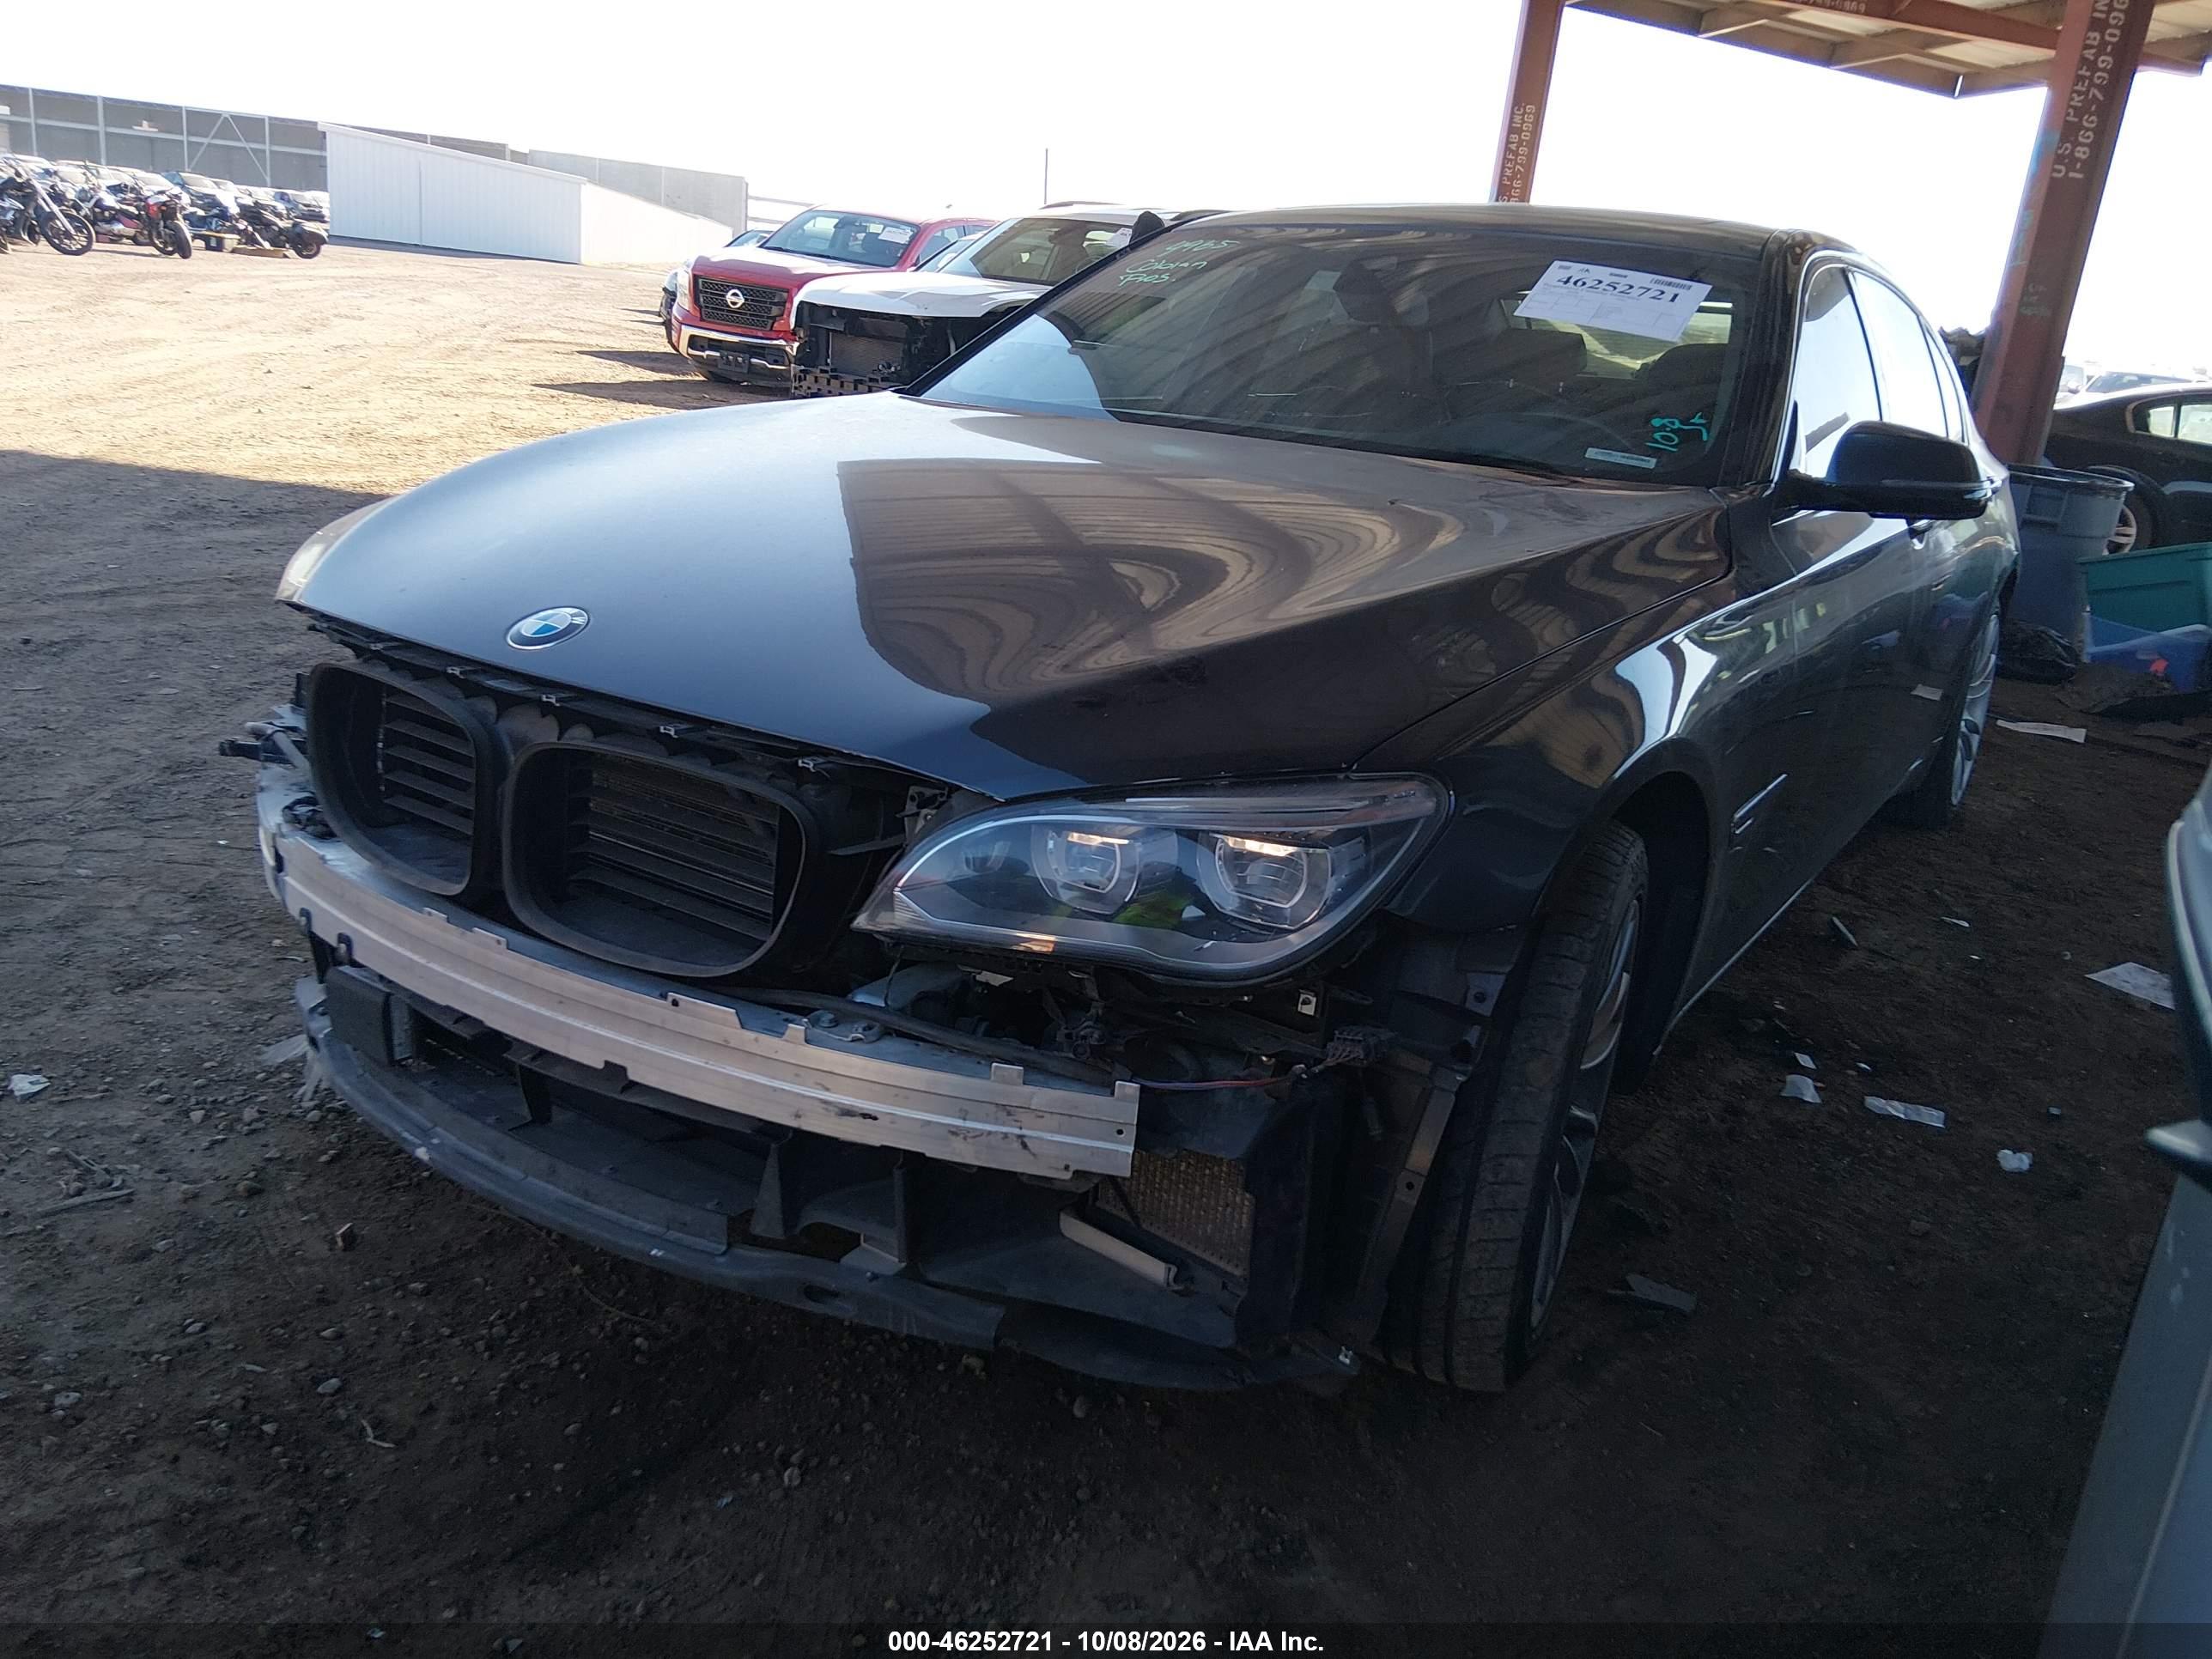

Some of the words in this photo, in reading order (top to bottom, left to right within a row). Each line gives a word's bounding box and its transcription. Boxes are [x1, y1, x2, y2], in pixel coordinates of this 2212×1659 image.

[2066, 31, 2100, 122] PREFAB
[1502, 134, 1519, 185] PREFAB
[1512, 103, 1524, 127] INC.
[1556, 274, 1680, 302] 46252721
